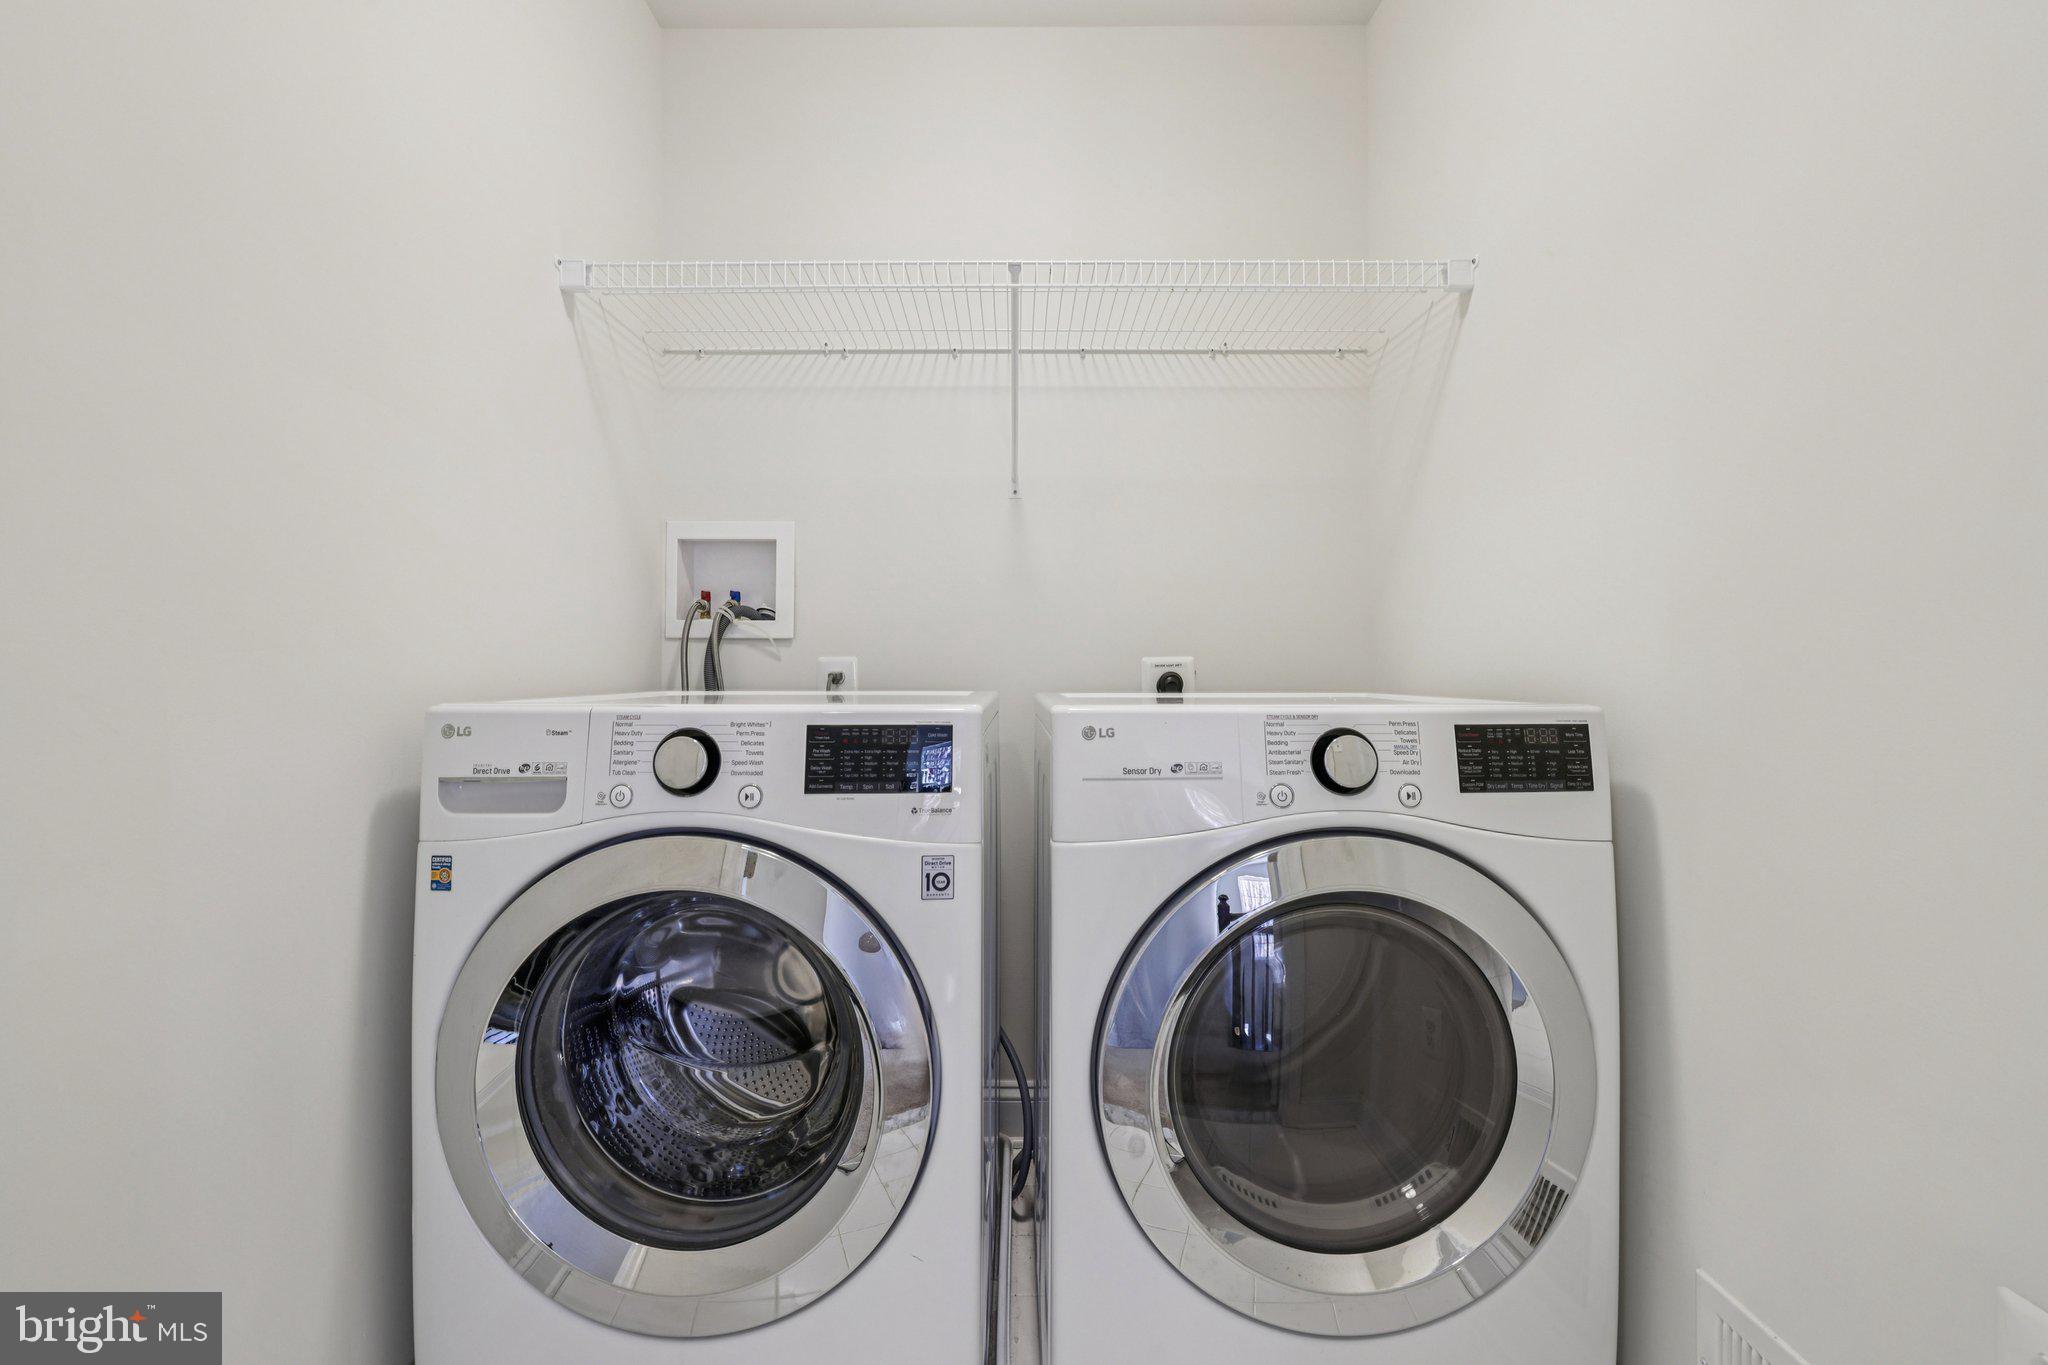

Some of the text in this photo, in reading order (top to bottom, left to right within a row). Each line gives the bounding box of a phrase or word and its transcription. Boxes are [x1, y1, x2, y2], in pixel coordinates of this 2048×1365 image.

[472, 767, 492, 775] Direct
[493, 767, 510, 775] Drive
[1122, 767, 1162, 776] Sensor Dry
[925, 872, 951, 892] 10
